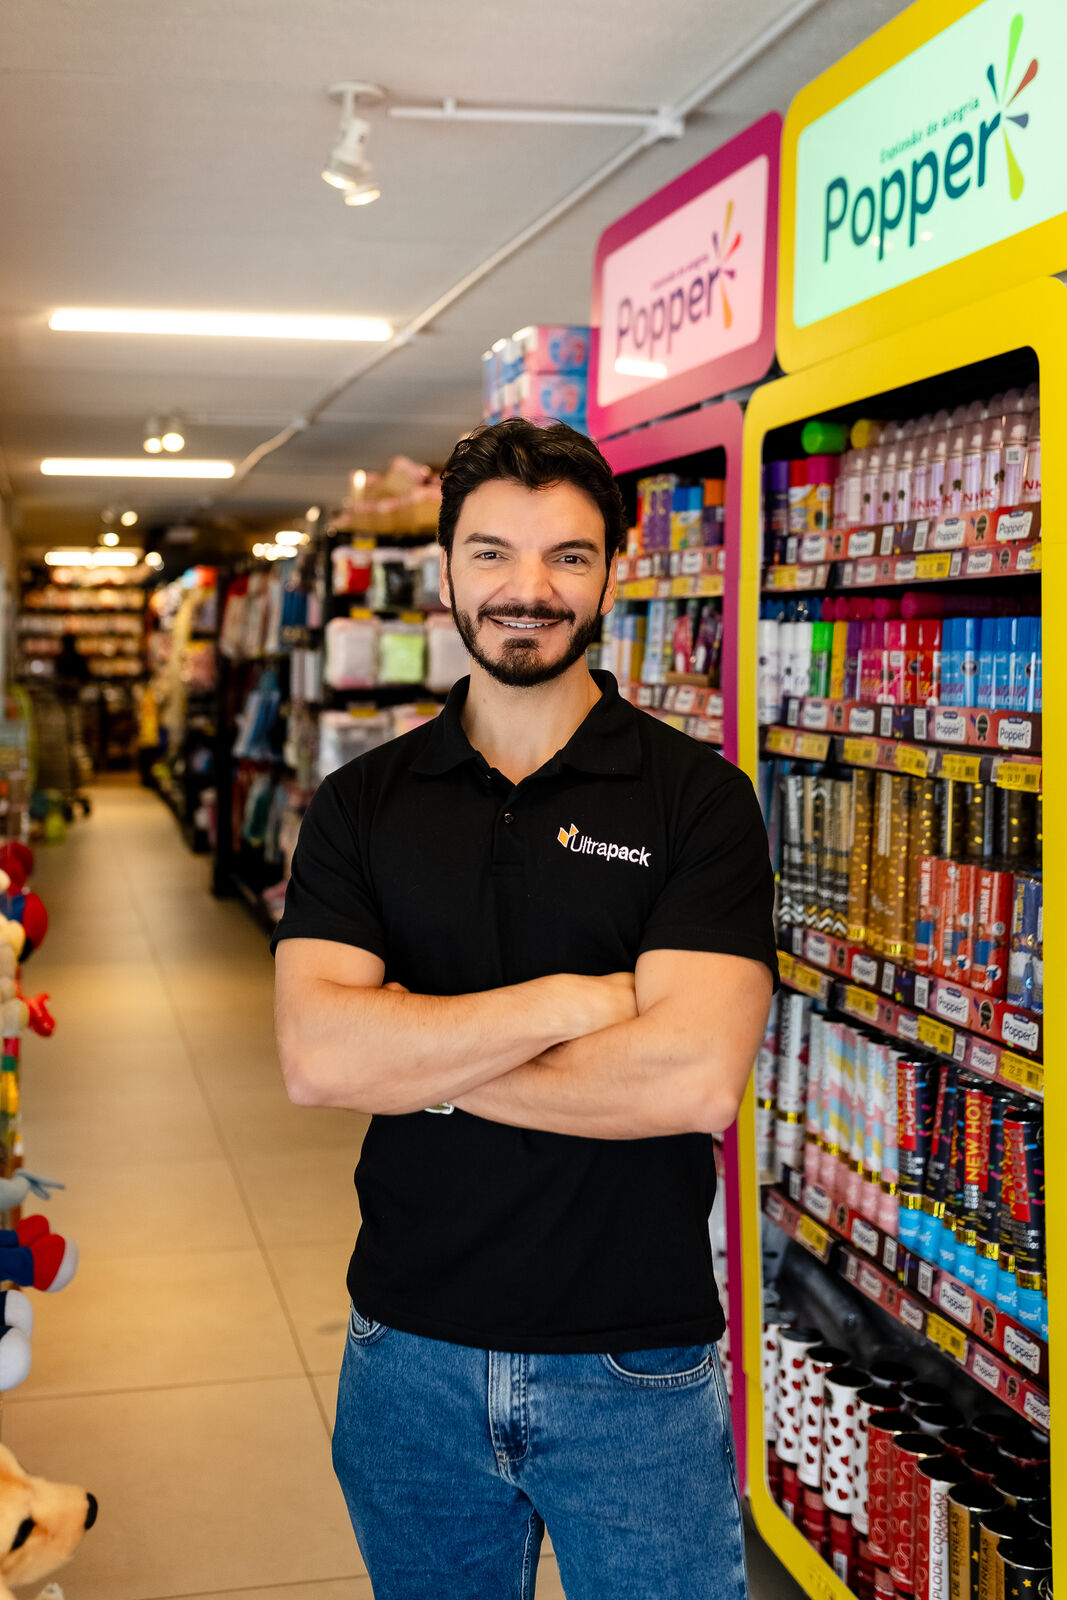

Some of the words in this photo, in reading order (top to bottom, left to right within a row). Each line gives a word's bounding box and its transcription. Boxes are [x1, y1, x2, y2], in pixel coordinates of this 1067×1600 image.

[823, 111, 1002, 263] Popper
[616, 267, 720, 361] Popper
[1000, 727, 1025, 743] Popper
[570, 834, 652, 868] Ultrapack
[1003, 1020, 1032, 1041] Popper
[965, 1095, 981, 1133] HOT
[965, 1138, 981, 1181] NEW
[1009, 1128, 1029, 1205] POPPER
